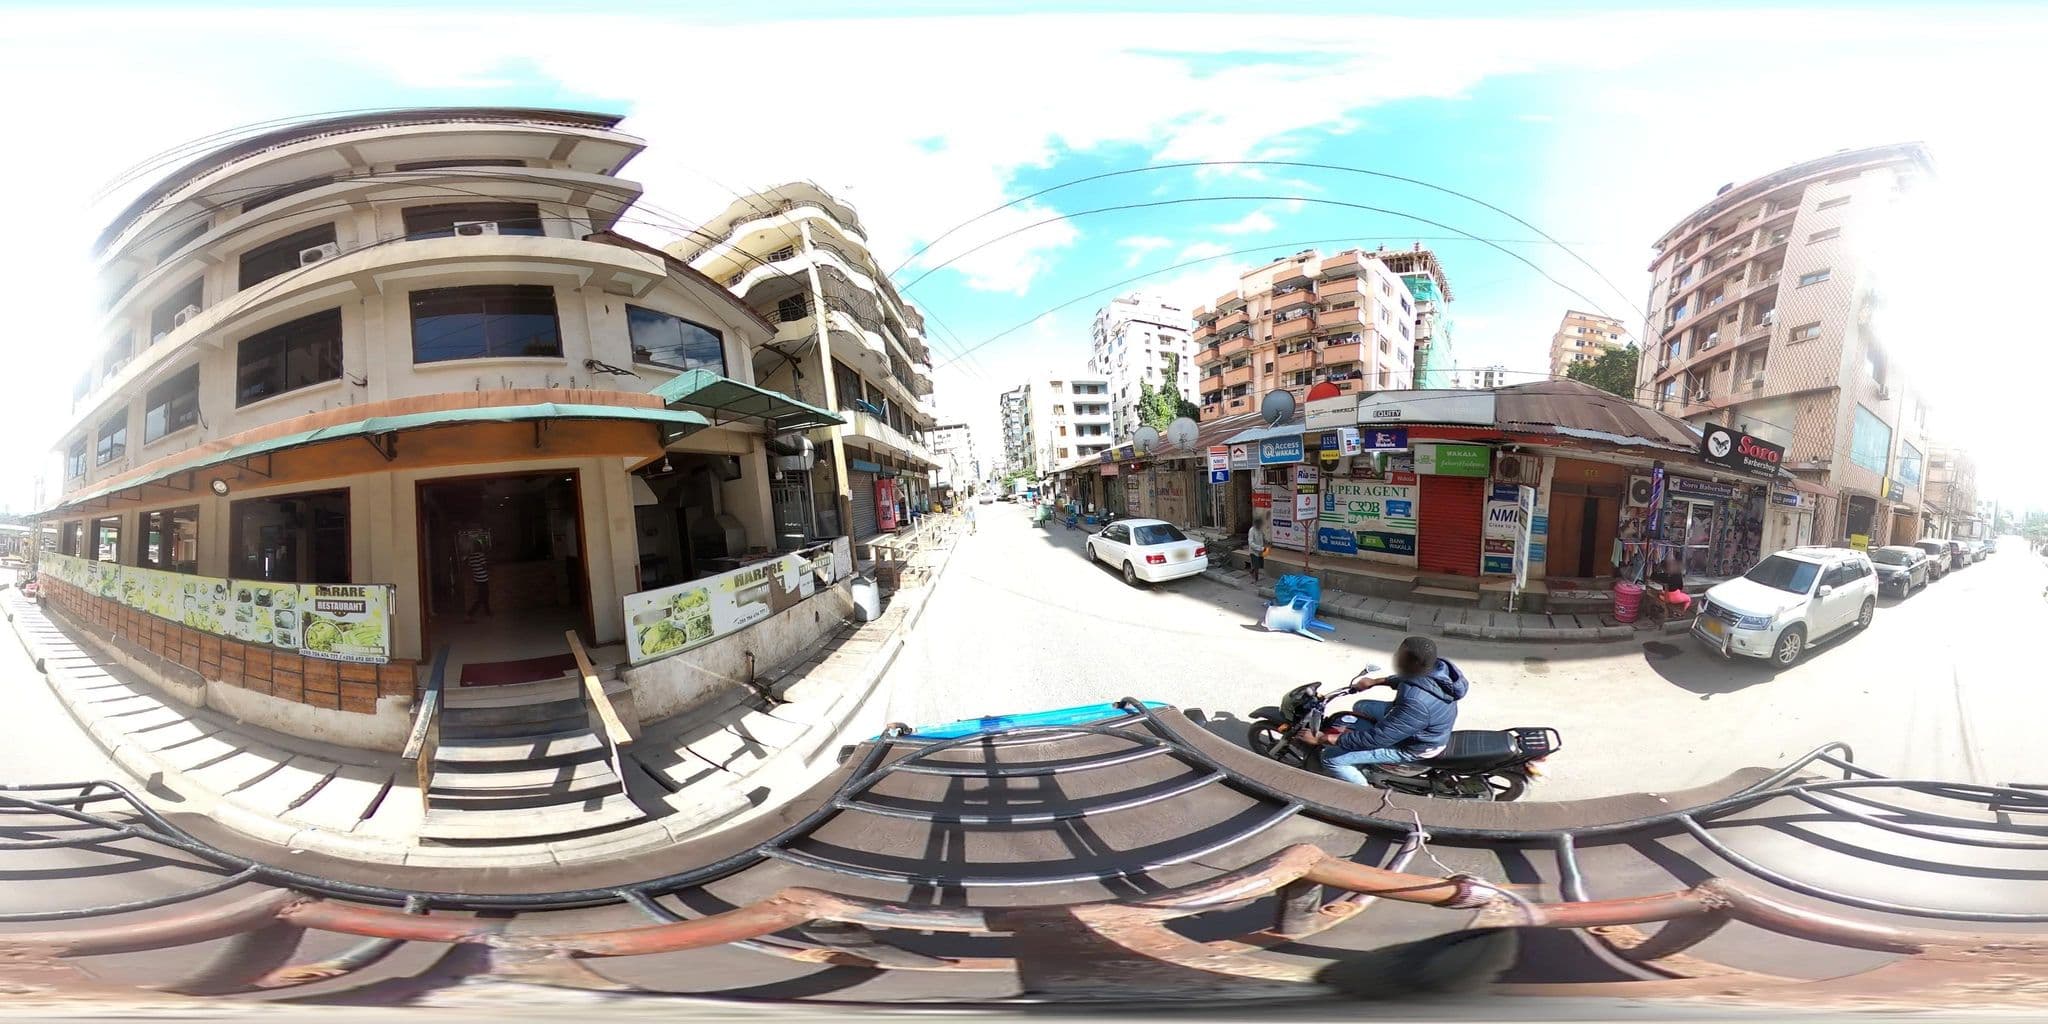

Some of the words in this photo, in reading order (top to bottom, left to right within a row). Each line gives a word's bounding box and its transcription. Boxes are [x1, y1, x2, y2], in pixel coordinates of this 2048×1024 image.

[1373, 410, 1401, 418] EQUITY
[1275, 441, 1299, 449] Access
[1738, 435, 1779, 463] Soro
[1275, 449, 1300, 457] WAKALA
[1743, 456, 1776, 473] Barbershop
[1328, 485, 1360, 495] UPER
[1364, 486, 1409, 498] AGENT
[1348, 501, 1380, 513] CRDB
[734, 560, 784, 587] HARARE
[315, 585, 366, 597] HARARE
[317, 601, 364, 612] RESTAURANT
